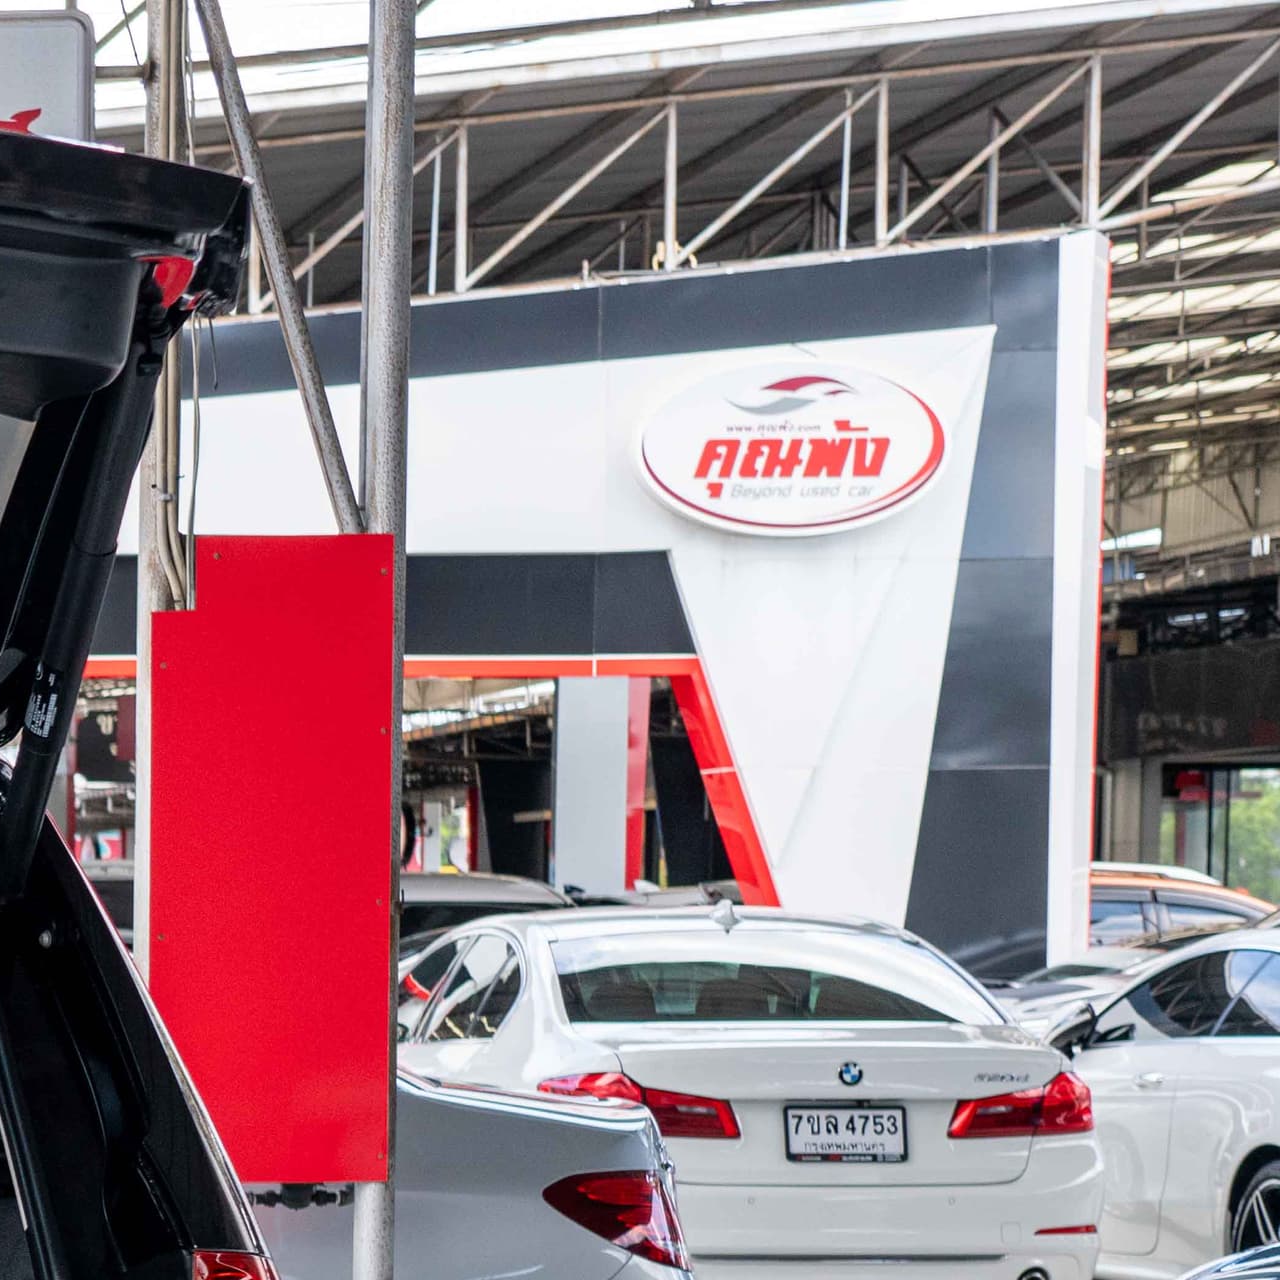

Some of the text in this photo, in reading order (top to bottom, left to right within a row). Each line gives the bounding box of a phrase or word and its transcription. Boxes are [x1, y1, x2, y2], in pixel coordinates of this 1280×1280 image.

[731, 484, 874, 500] Beyond used car
[845, 1114, 898, 1136] 4753
